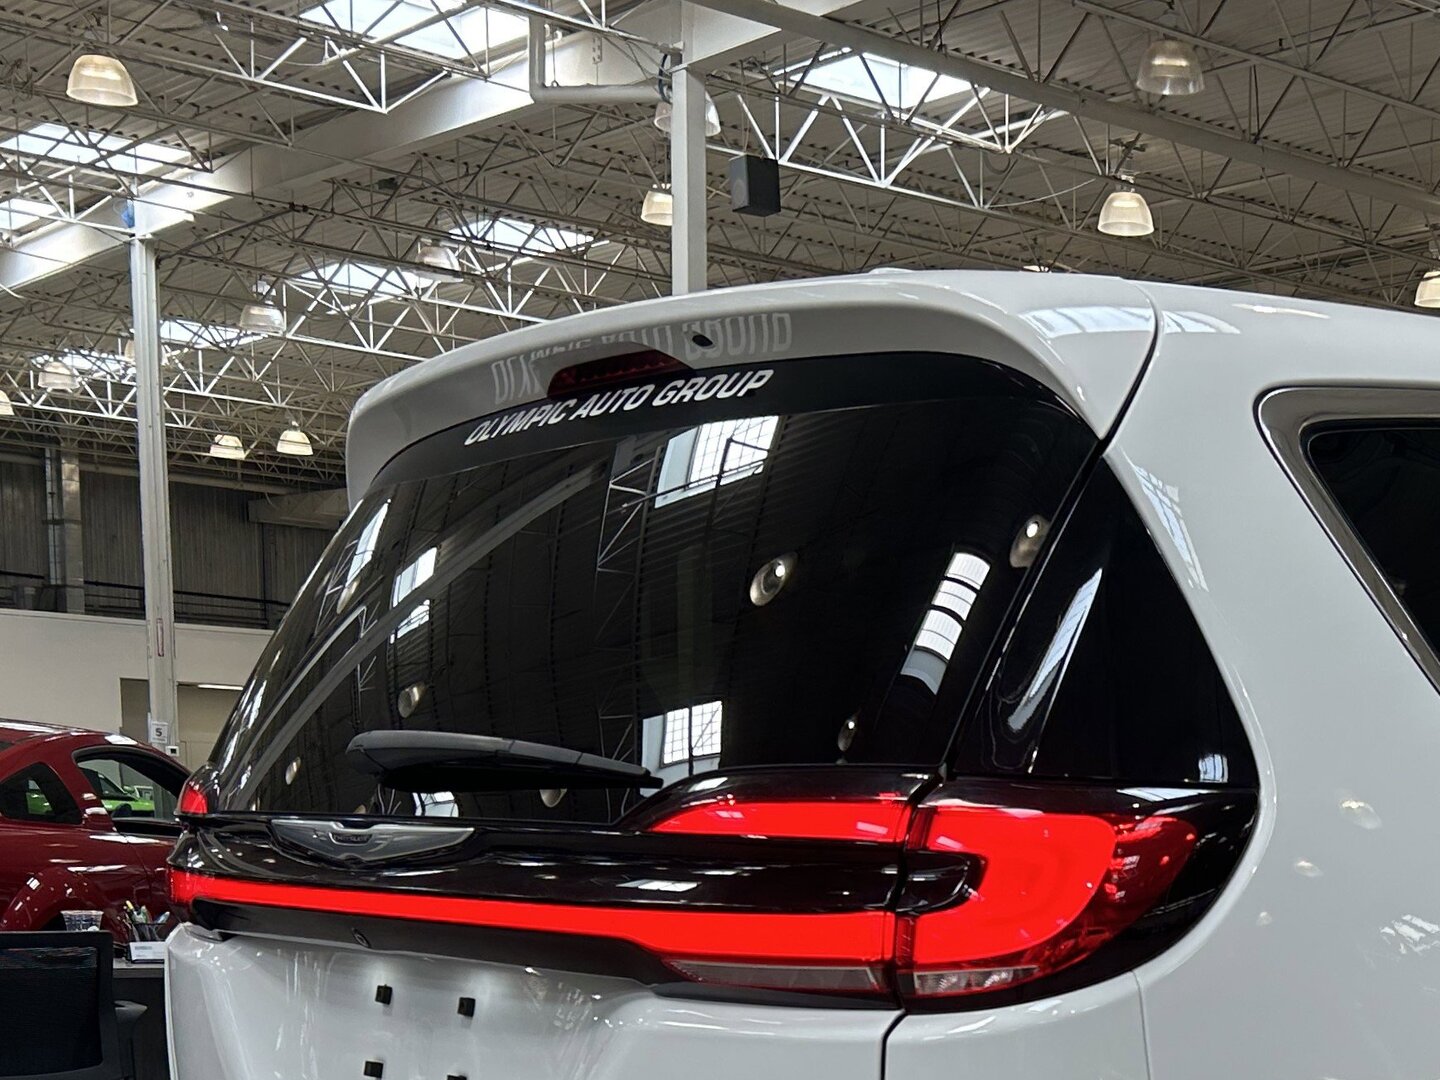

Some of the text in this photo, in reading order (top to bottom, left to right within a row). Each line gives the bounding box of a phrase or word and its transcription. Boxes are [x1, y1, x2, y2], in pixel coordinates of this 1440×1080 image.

[464, 369, 774, 446] OLYMPIC AUTO GROUP
